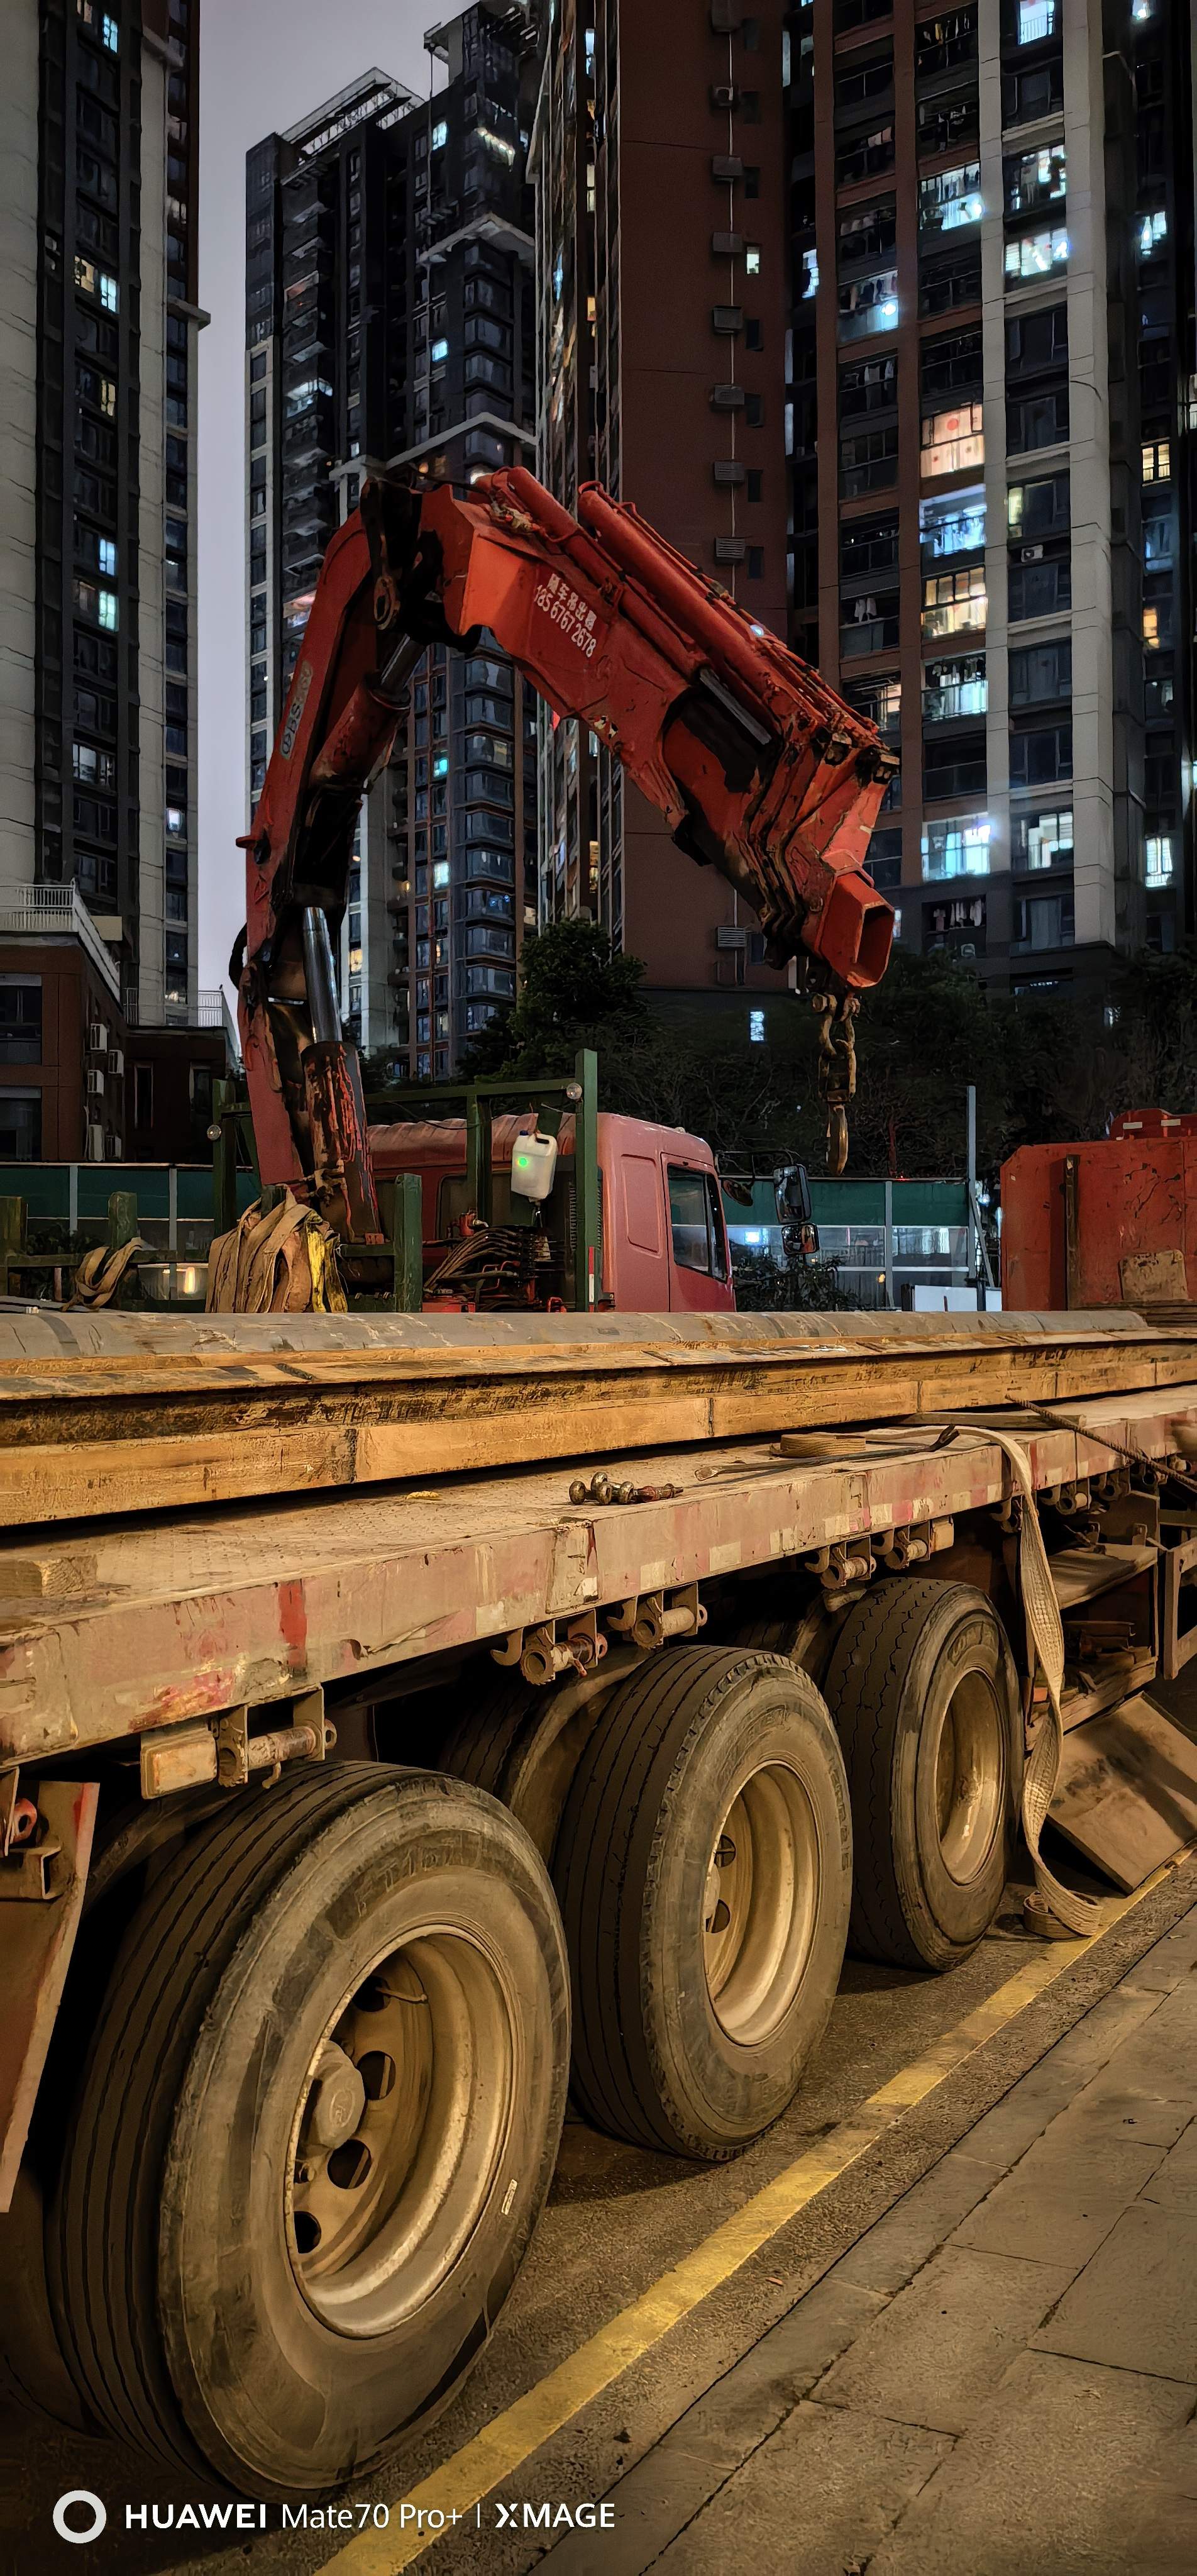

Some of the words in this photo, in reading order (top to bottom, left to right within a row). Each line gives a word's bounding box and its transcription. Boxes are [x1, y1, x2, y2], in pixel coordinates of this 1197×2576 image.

[534, 585, 554, 612] 185
[550, 601, 575, 633] 6767
[571, 623, 597, 658] 2678
